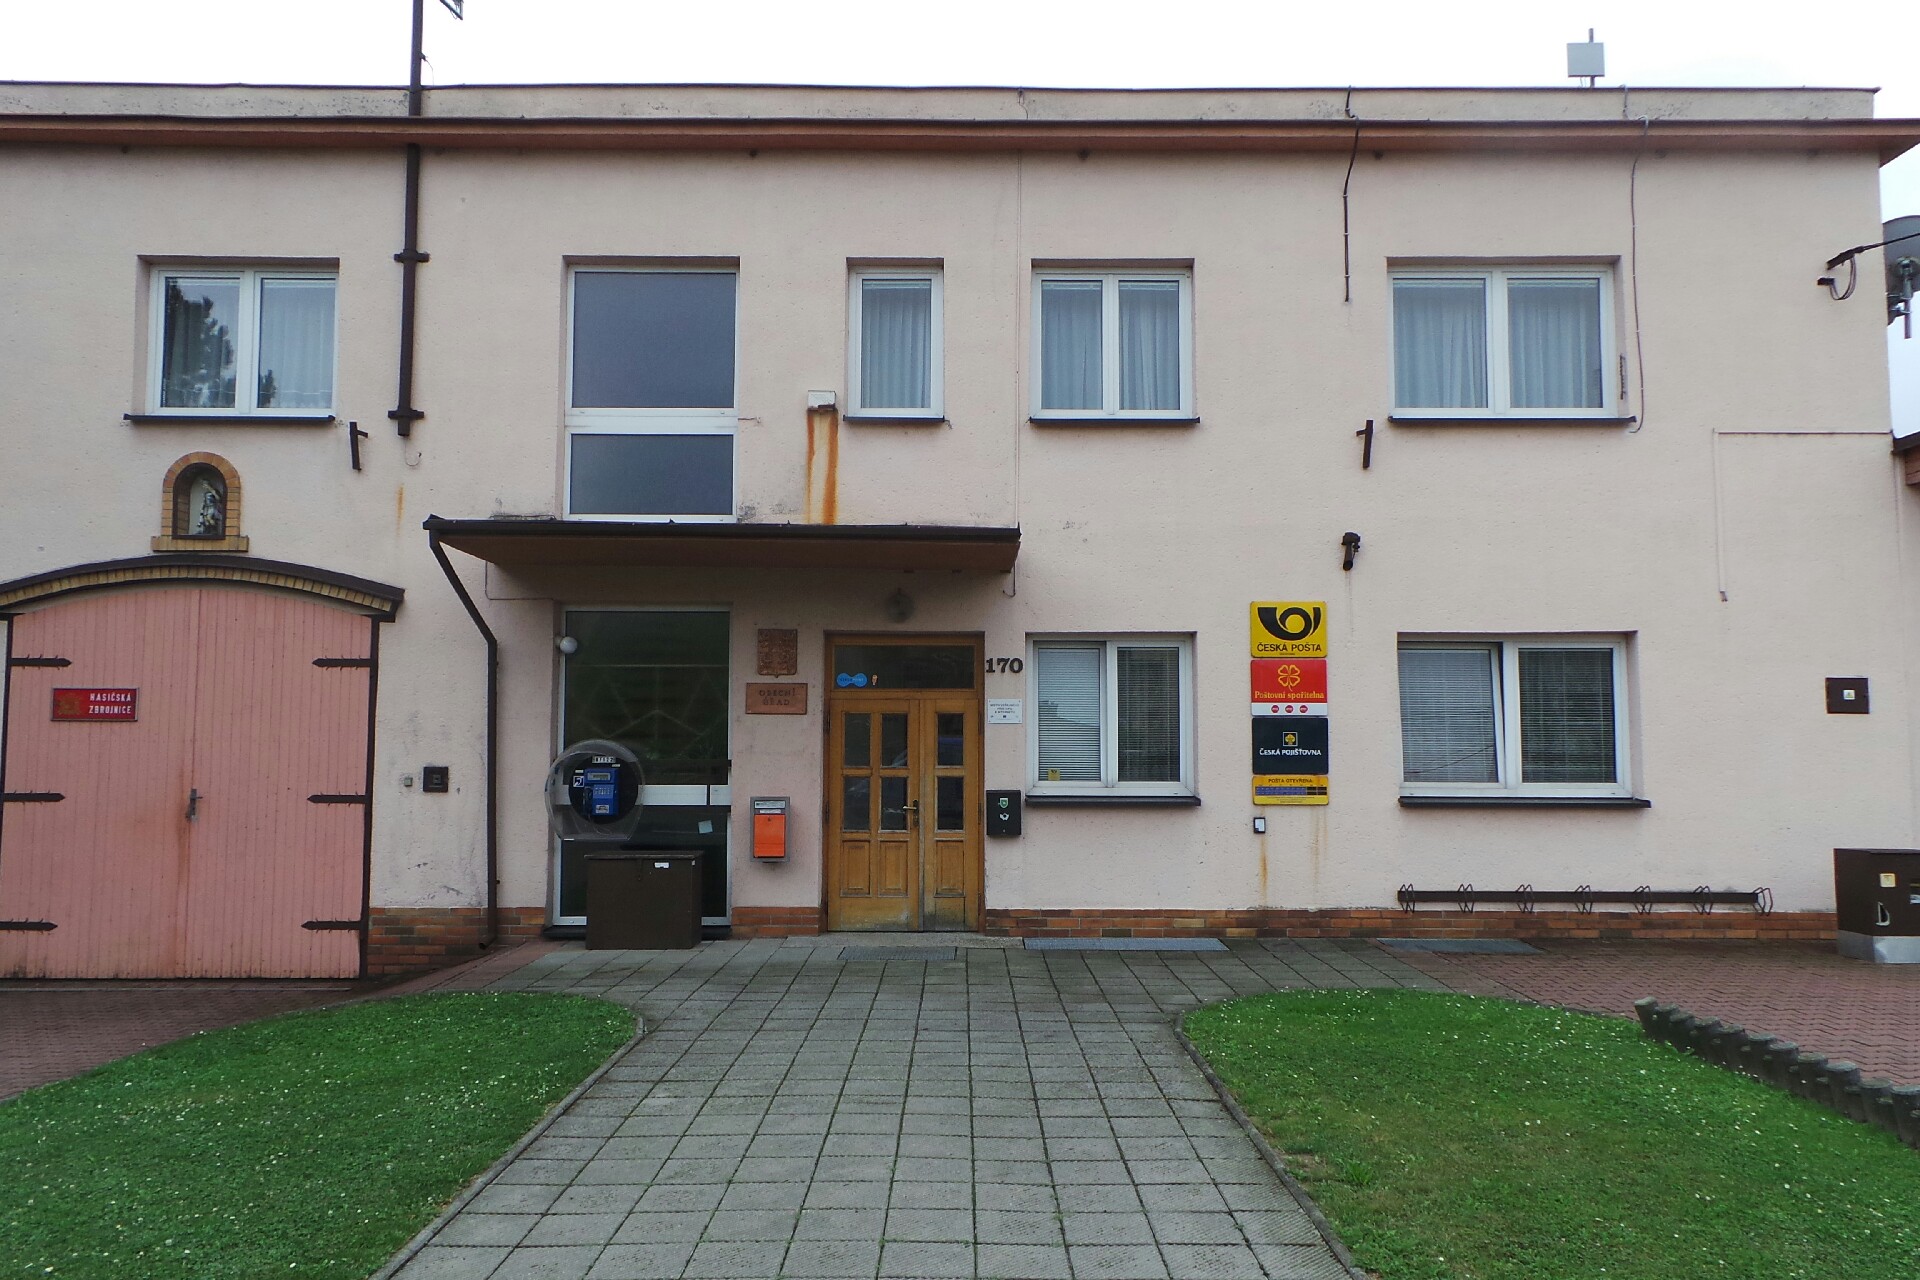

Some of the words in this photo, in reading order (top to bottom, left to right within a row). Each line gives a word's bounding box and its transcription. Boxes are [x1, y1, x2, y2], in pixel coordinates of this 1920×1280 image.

[1257, 642, 1288, 652] ČESKÁ
[1291, 642, 1322, 652] POŠTA
[985, 657, 1024, 674] 170
[89, 692, 131, 702] HASIČSKÁ
[1254, 690, 1286, 699] Poštovní
[1287, 690, 1325, 700] spořitelna
[88, 705, 132, 714] ZBROJNICE
[1259, 747, 1281, 756] ČESKÁ
[1281, 747, 1322, 756] POJIŠŤOVNA
